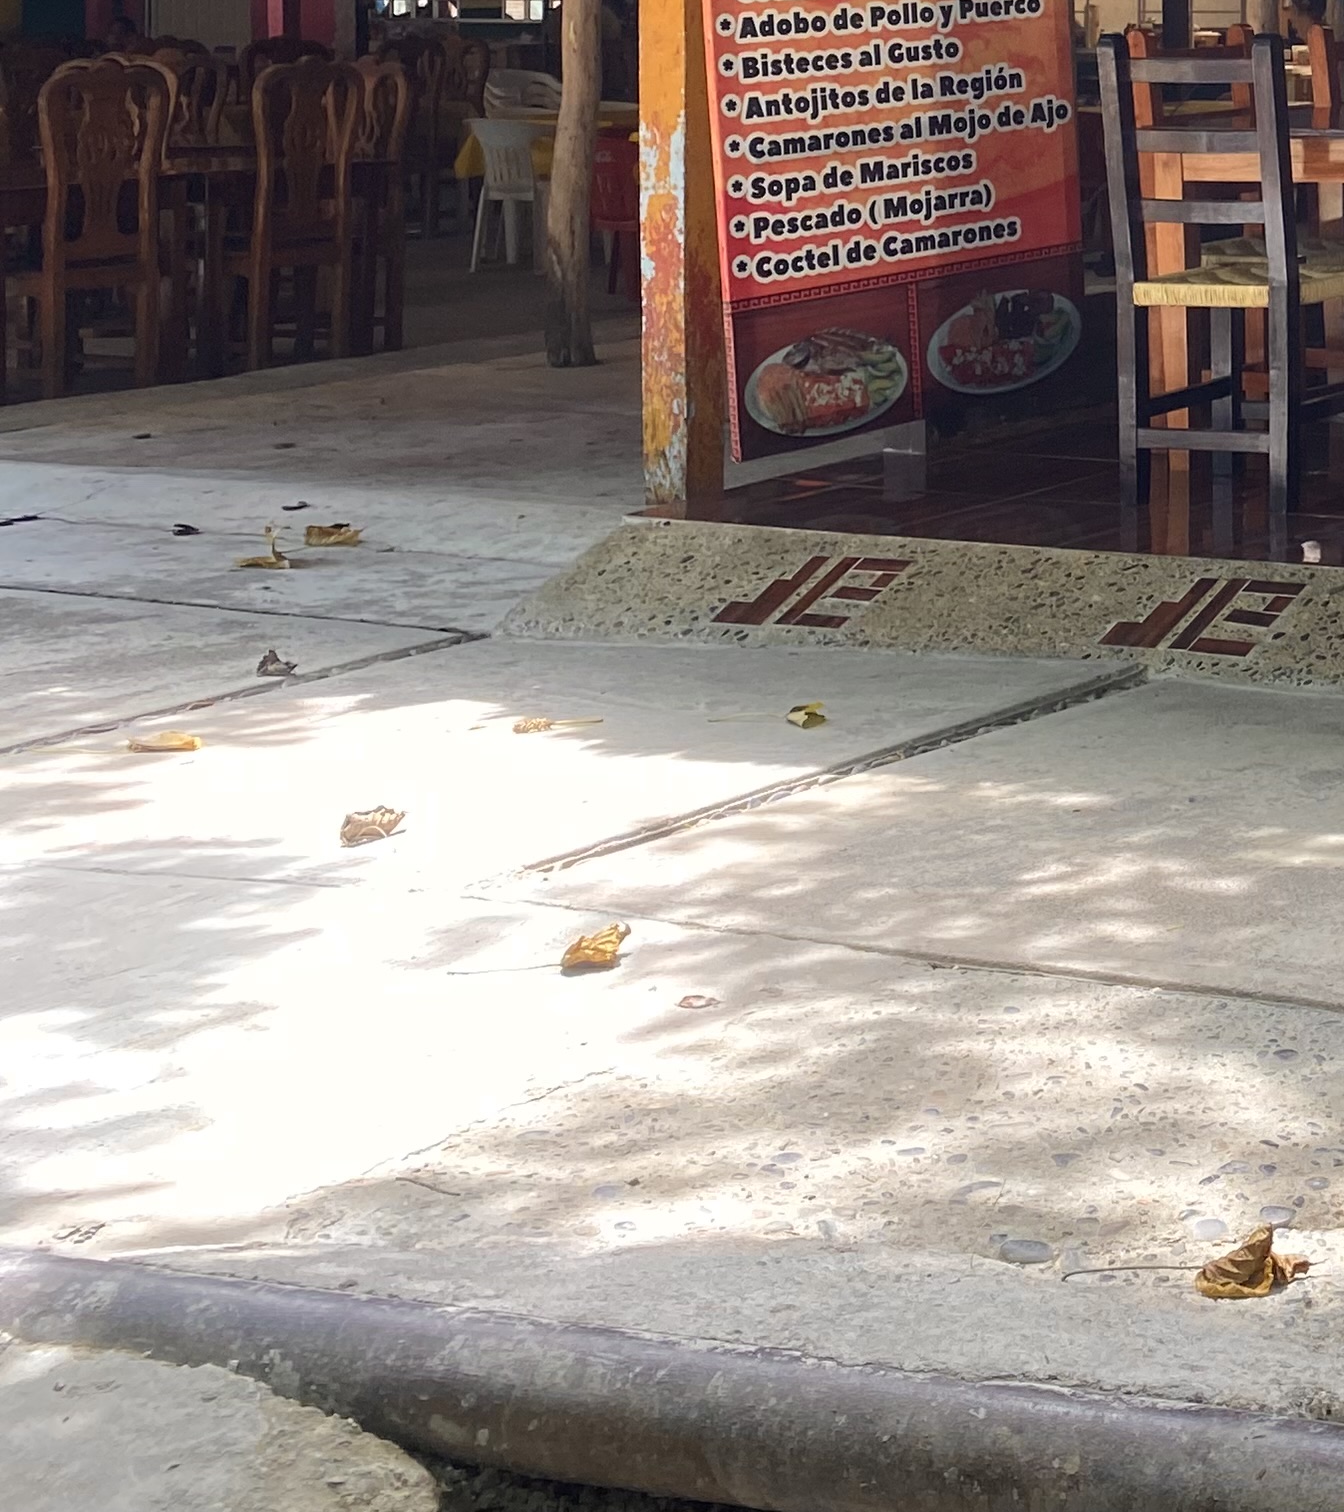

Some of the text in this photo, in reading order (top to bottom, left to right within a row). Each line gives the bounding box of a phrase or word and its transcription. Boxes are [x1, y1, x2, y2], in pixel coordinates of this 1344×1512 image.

[739, 12, 827, 39] Adobo
[834, 7, 863, 29] de
[870, 2, 934, 26] Pollo
[939, 4, 952, 28] y
[743, 38, 959, 79] Bisteces al Gusto
[745, 68, 1022, 118] Antojitos de la Región
[748, 100, 1069, 158] Camarones al Mojo de Ajo
[751, 151, 973, 201] Sopa de Mariscos
[754, 207, 861, 238] Pescado
[755, 218, 1017, 278] Coctel de Camarones
